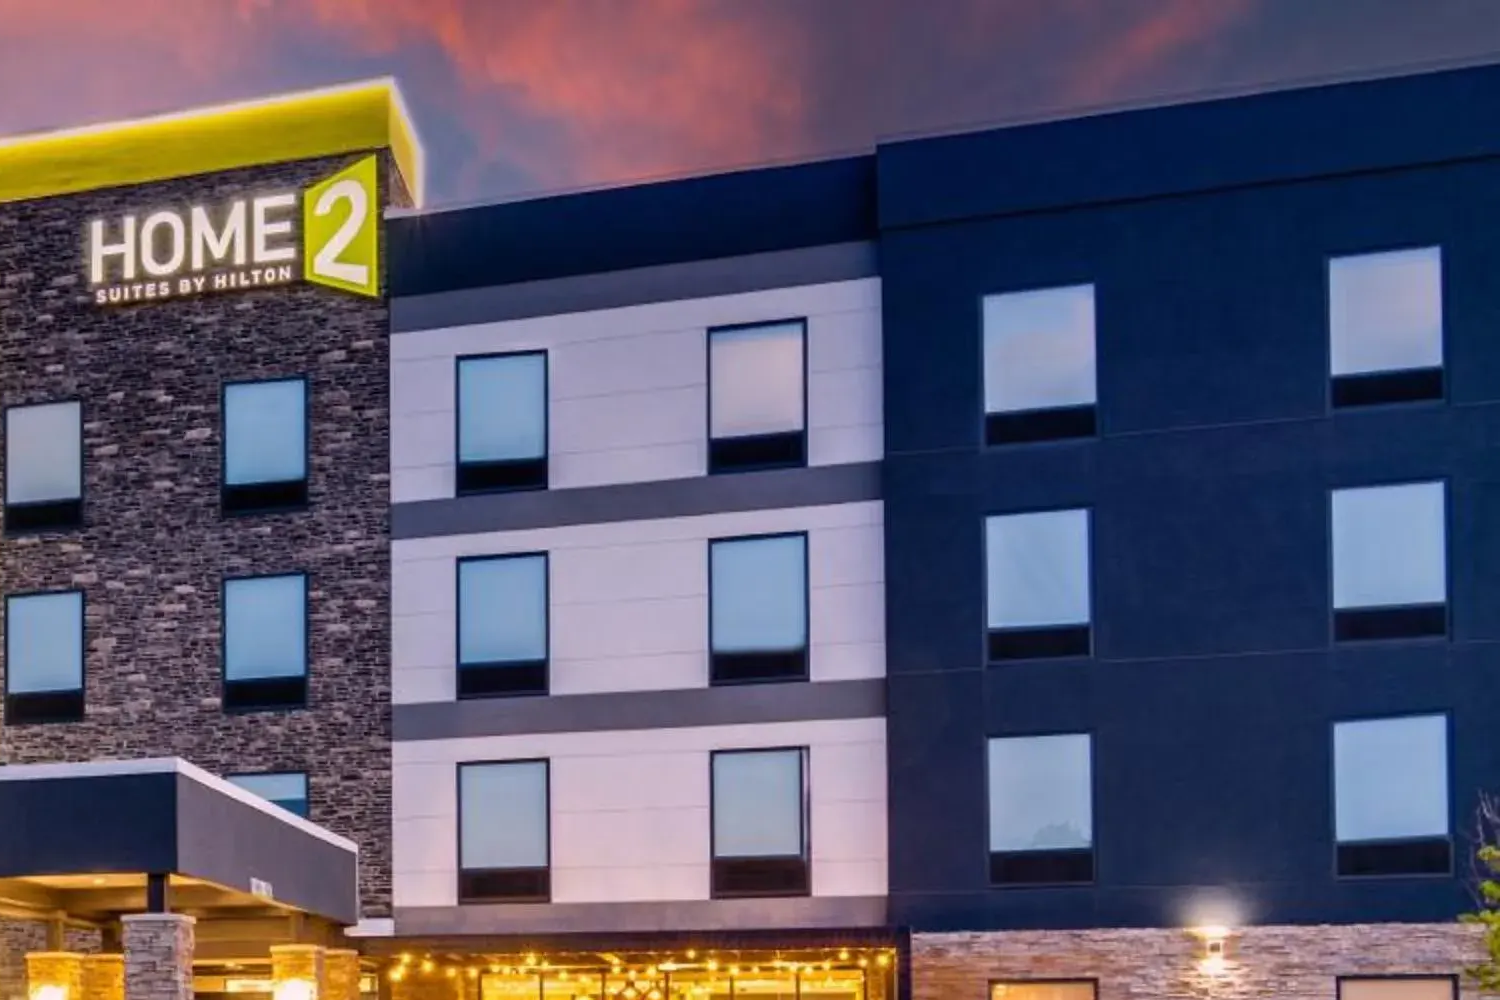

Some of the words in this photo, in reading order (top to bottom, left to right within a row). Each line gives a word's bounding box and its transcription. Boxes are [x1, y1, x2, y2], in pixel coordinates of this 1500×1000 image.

[91, 194, 296, 283] HOME
[313, 179, 369, 286] 2
[96, 281, 170, 304] SUITES
[179, 276, 205, 294] BY
[214, 265, 292, 289] HILTON
